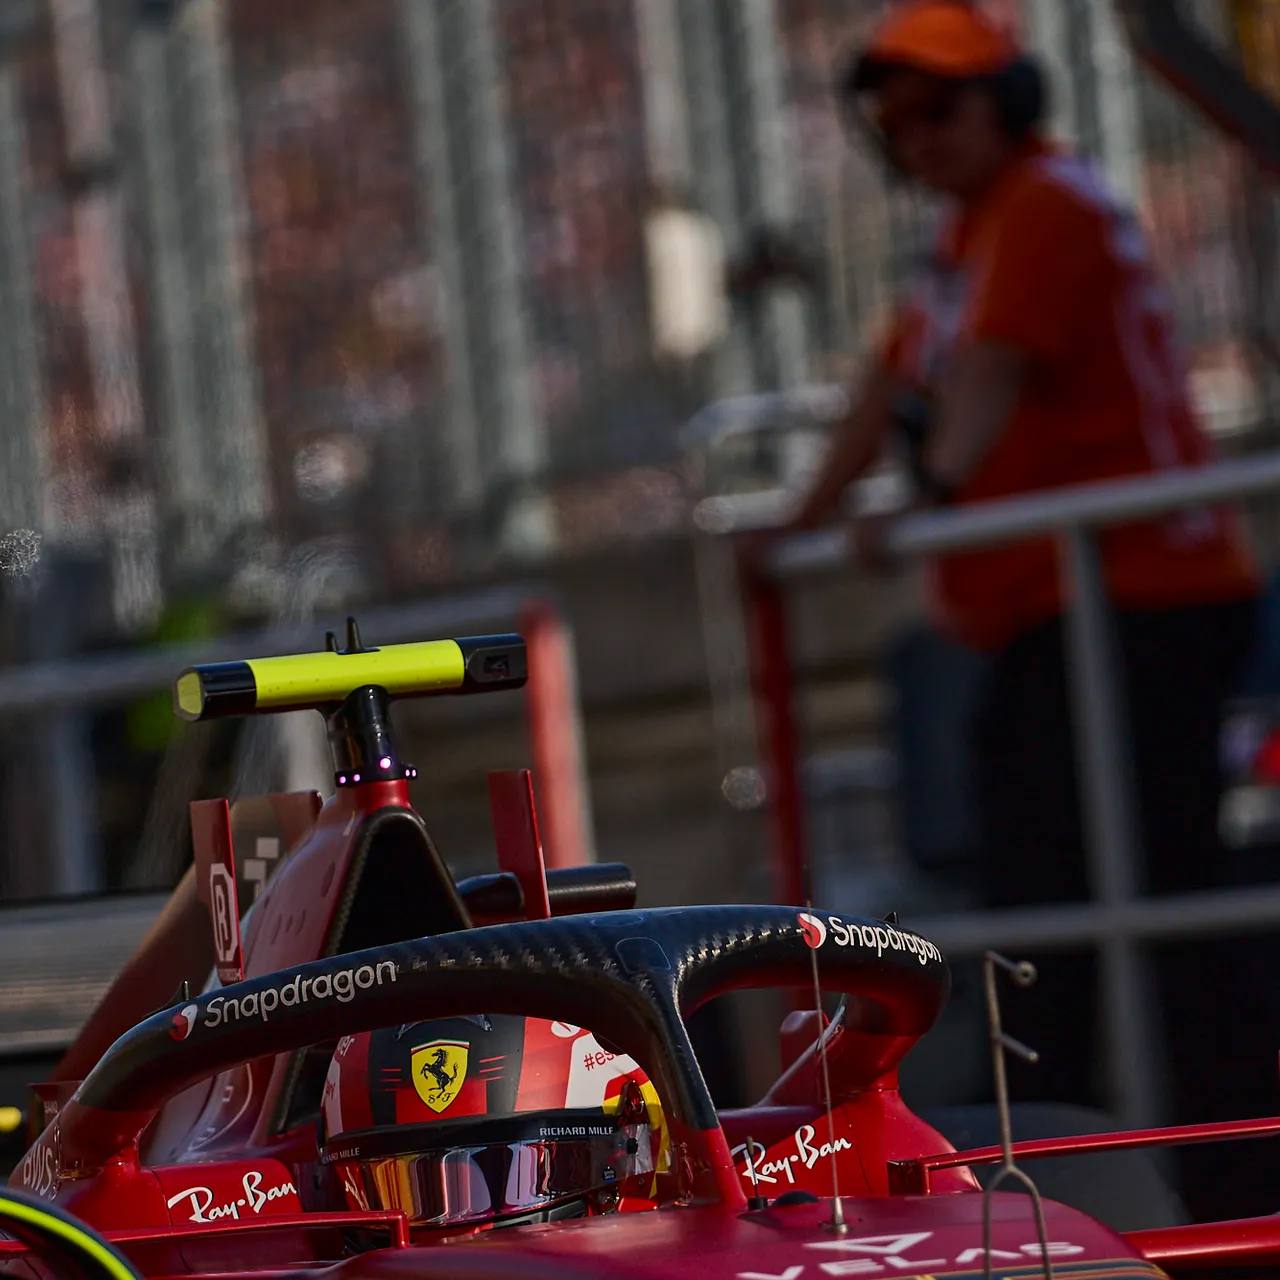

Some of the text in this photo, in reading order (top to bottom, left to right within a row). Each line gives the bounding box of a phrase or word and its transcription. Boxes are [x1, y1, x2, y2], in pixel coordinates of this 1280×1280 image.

[827, 915, 943, 966] Snapdragon
[204, 961, 398, 1028] Snapdragon
[539, 1126, 614, 1136] RICHARD MILLE
[730, 1124, 853, 1186] Ray-Ban
[167, 1171, 298, 1223] Ray-Ban
